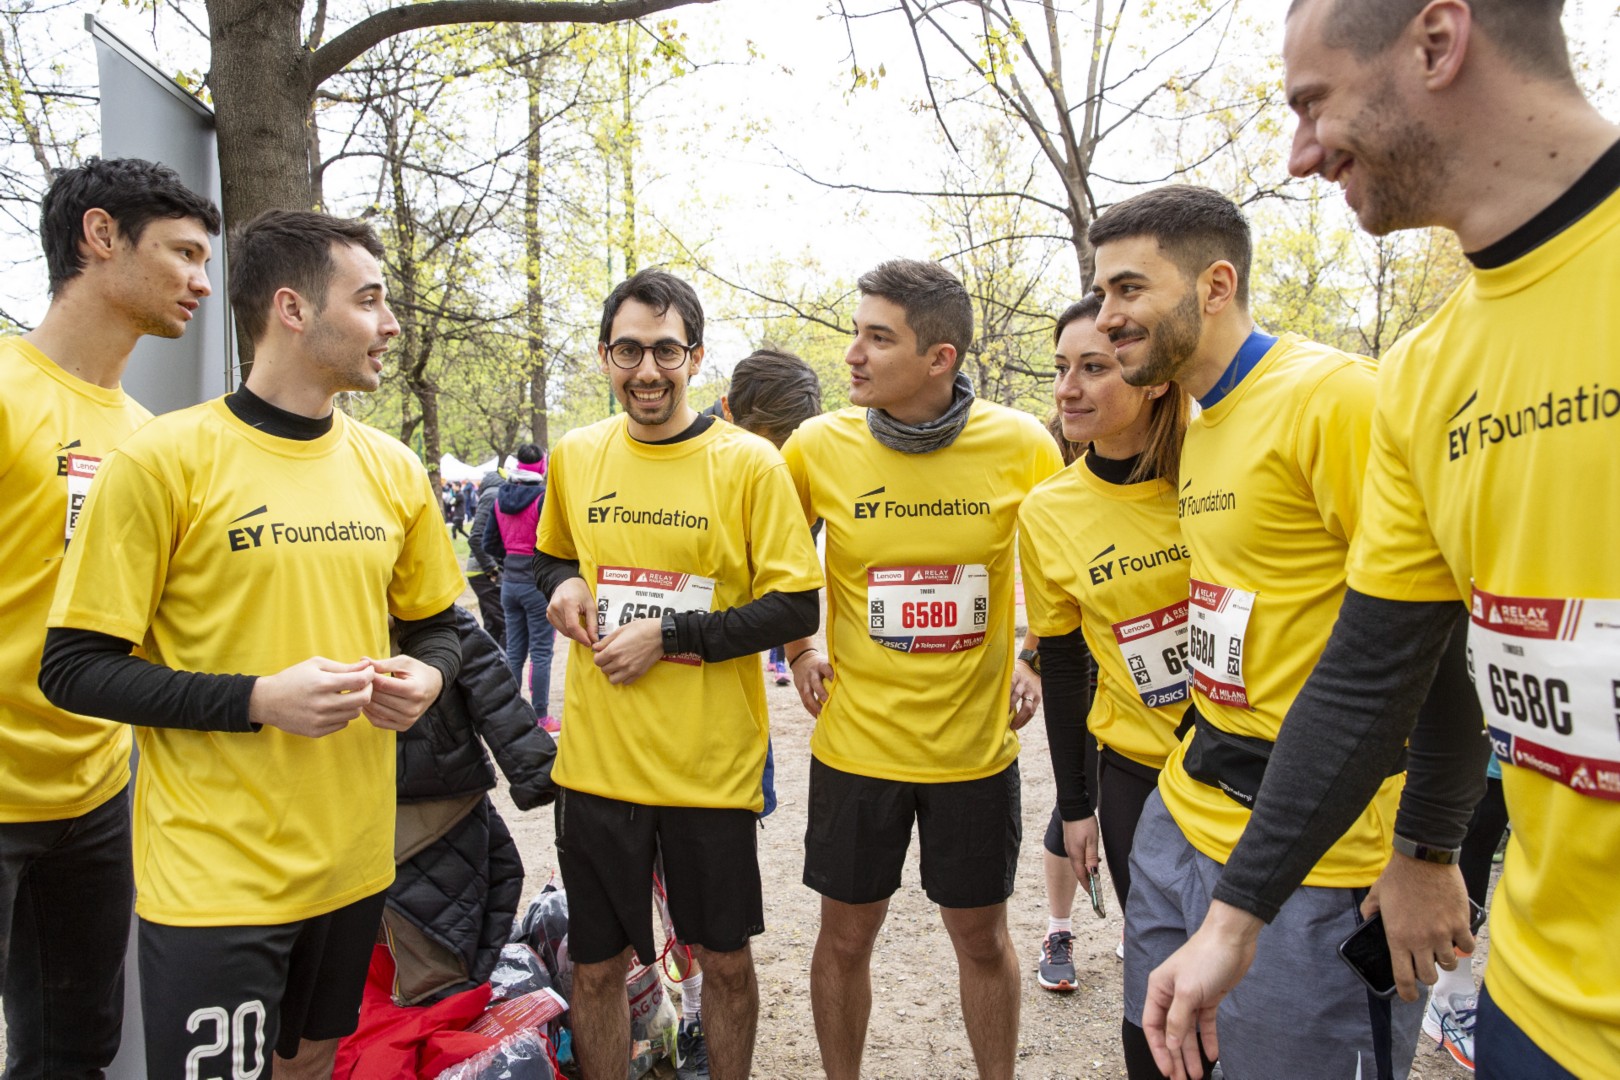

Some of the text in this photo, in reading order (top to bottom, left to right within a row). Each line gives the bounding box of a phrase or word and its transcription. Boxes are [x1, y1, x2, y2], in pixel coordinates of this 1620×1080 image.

[1448, 383, 1620, 462] EY Foundatio
[854, 499, 991, 519] EY Foundation
[1187, 489, 1236, 517] Foundation
[588, 505, 709, 531] EY Foundation
[228, 520, 387, 552] EY Foundation
[605, 571, 628, 580] Lenovo
[649, 572, 673, 581] RELAY
[1088, 543, 1191, 586] EY Founda
[1200, 588, 1218, 599] RELAY
[902, 601, 958, 629] 658D
[1501, 605, 1547, 620] RELAY
[1122, 622, 1151, 635] Lenovo
[1190, 624, 1215, 669] 658A
[1488, 663, 1573, 736] 658C
[185, 999, 266, 1080] 20
